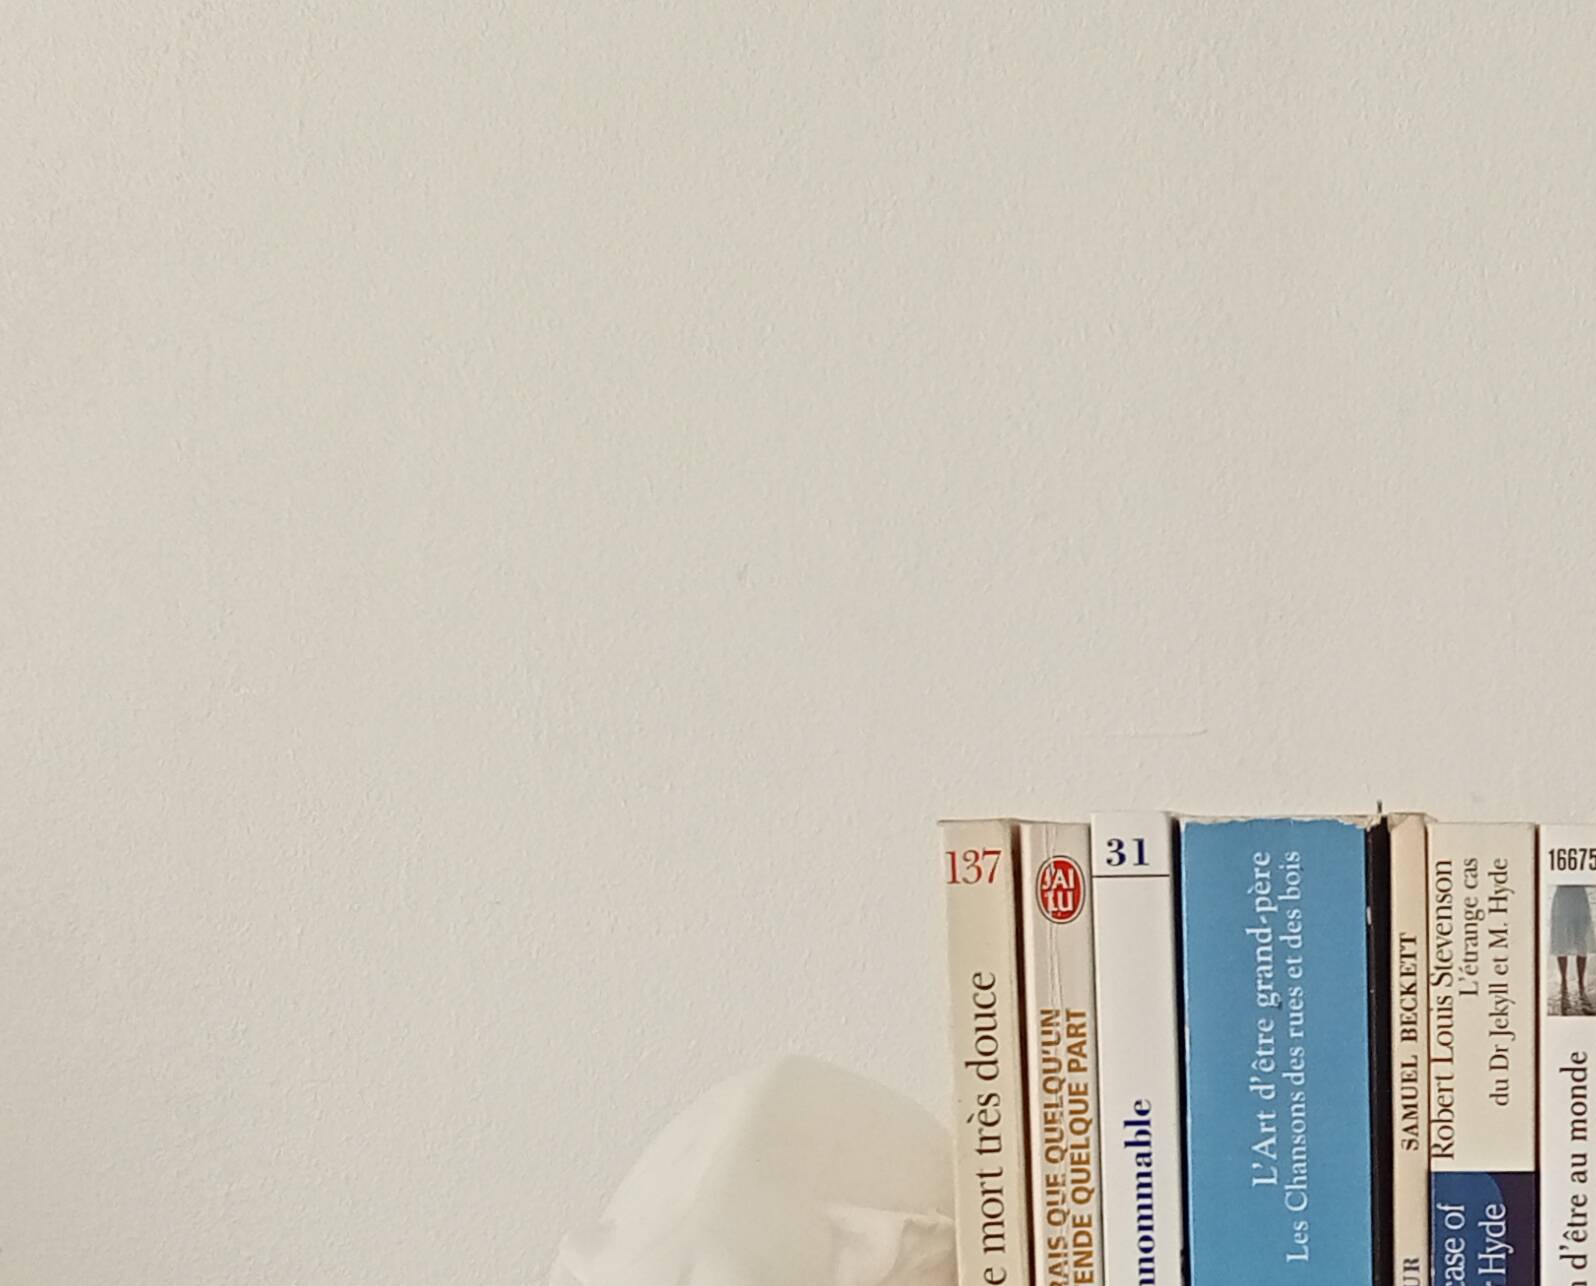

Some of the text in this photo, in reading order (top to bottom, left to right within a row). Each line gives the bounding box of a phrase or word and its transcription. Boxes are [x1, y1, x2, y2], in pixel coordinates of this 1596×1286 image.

[945, 850, 1002, 885] 137
[1106, 838, 1149, 868] 31
[1458, 857, 1485, 996] L'étrange cas
[965, 971, 998, 1080] douce
[1246, 851, 1281, 1186] L'Art d'être grand-père
[1430, 859, 1455, 1161] Robert Louis Stevenson
[1487, 857, 1516, 1106] du Dr Jekyll et M. Hyde
[1065, 1008, 1088, 1073] PART
[1278, 851, 1309, 1262] Les Chansons des rues et des bois
[1400, 932, 1420, 1151] SAMUEL BECKETT
[968, 1093, 1001, 1156] très
[1040, 1009, 1068, 1164] QUELQU'UN
[1559, 1051, 1588, 1141] monde
[1068, 1082, 1095, 1205] QUELQUE
[1573, 1151, 1588, 1185] au
[976, 1162, 1005, 1254] mort
[1046, 1173, 1071, 1227] QUE
[1437, 1202, 1466, 1229] of
[1478, 1203, 1513, 1274] Hyde
[1558, 1193, 1588, 1270] d'être
